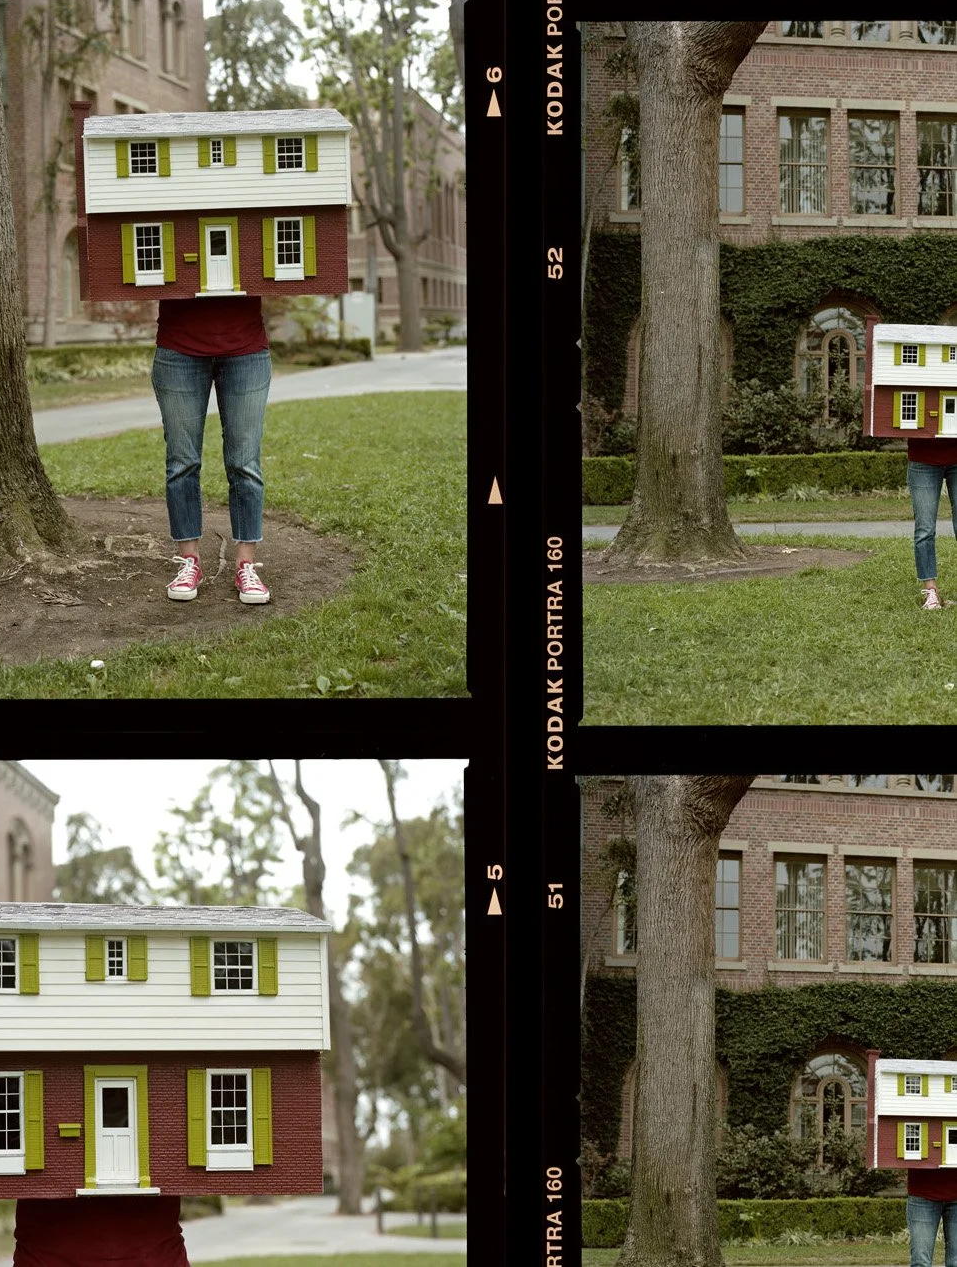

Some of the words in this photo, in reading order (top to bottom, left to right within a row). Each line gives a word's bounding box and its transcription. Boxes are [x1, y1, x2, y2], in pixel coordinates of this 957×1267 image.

[486, 66, 503, 83] 6
[546, 43, 564, 135] KODAK
[547, 247, 564, 280] 52
[546, 536, 564, 572] 160
[546, 580, 564, 671] PORTRA
[546, 678, 564, 770] KODAK
[487, 864, 504, 881] 5
[547, 883, 564, 909] 51
[546, 1166, 563, 1203] 160
